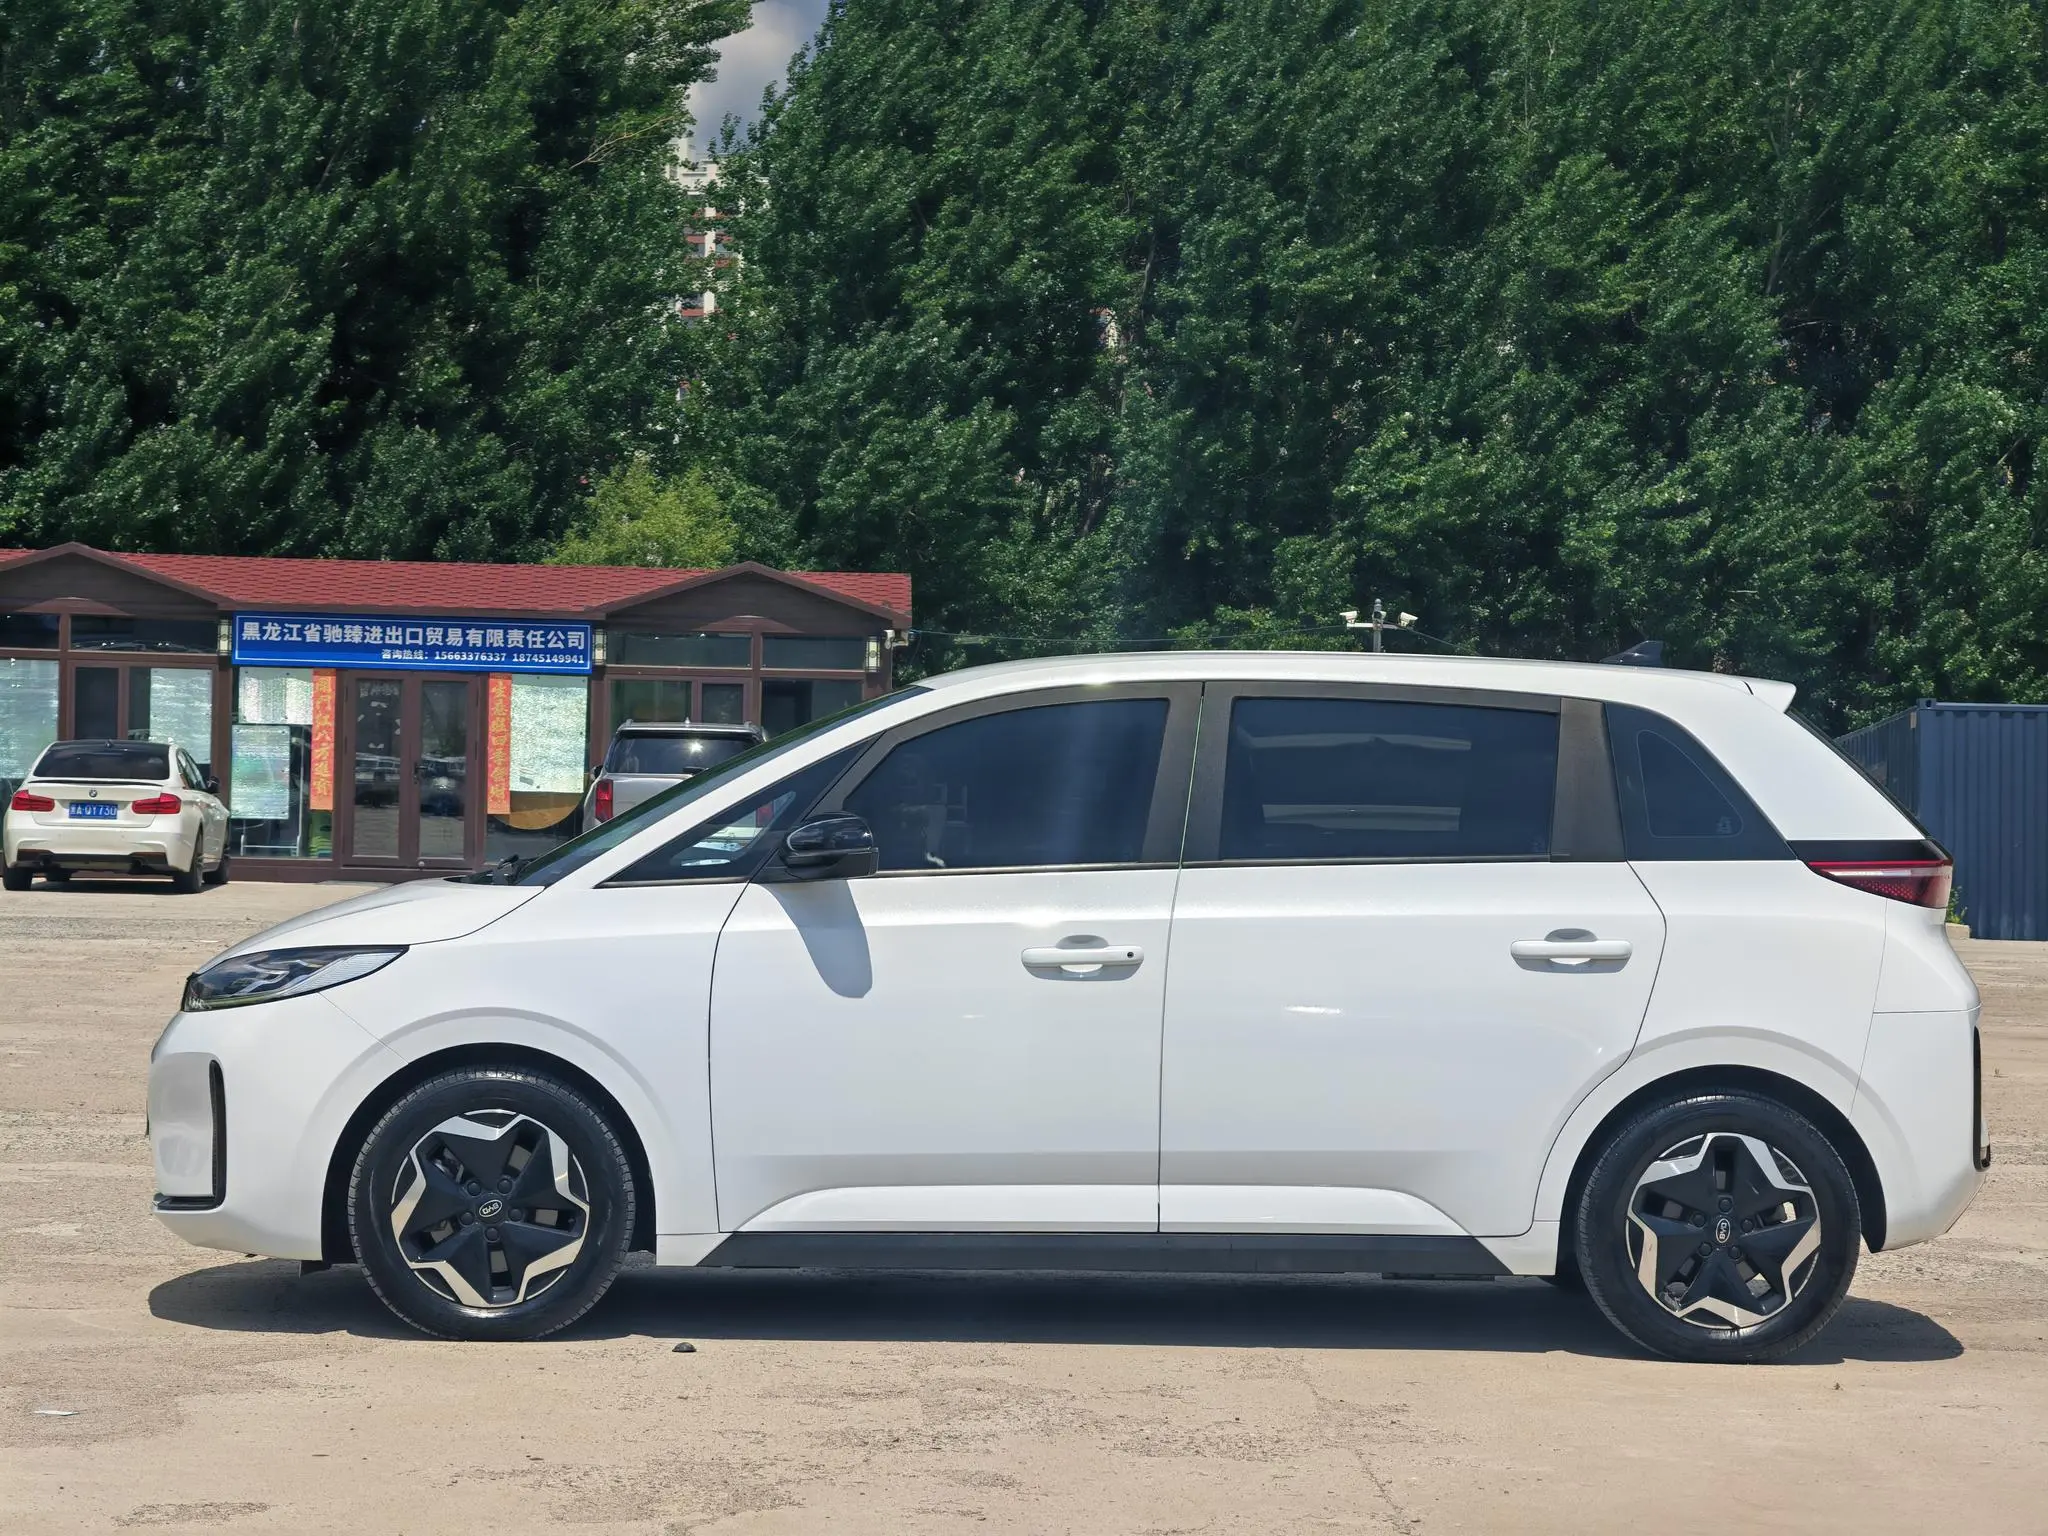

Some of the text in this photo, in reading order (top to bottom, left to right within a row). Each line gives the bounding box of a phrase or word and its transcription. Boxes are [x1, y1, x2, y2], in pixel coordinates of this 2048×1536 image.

[241, 622, 585, 650] 黑龙江省驰臻进出口贸易有限责任公司
[434, 650, 506, 662] 15663376337
[512, 652, 585, 664] 18745149941
[481, 1201, 500, 1215] BYD
[1718, 1221, 1728, 1240] BYD
